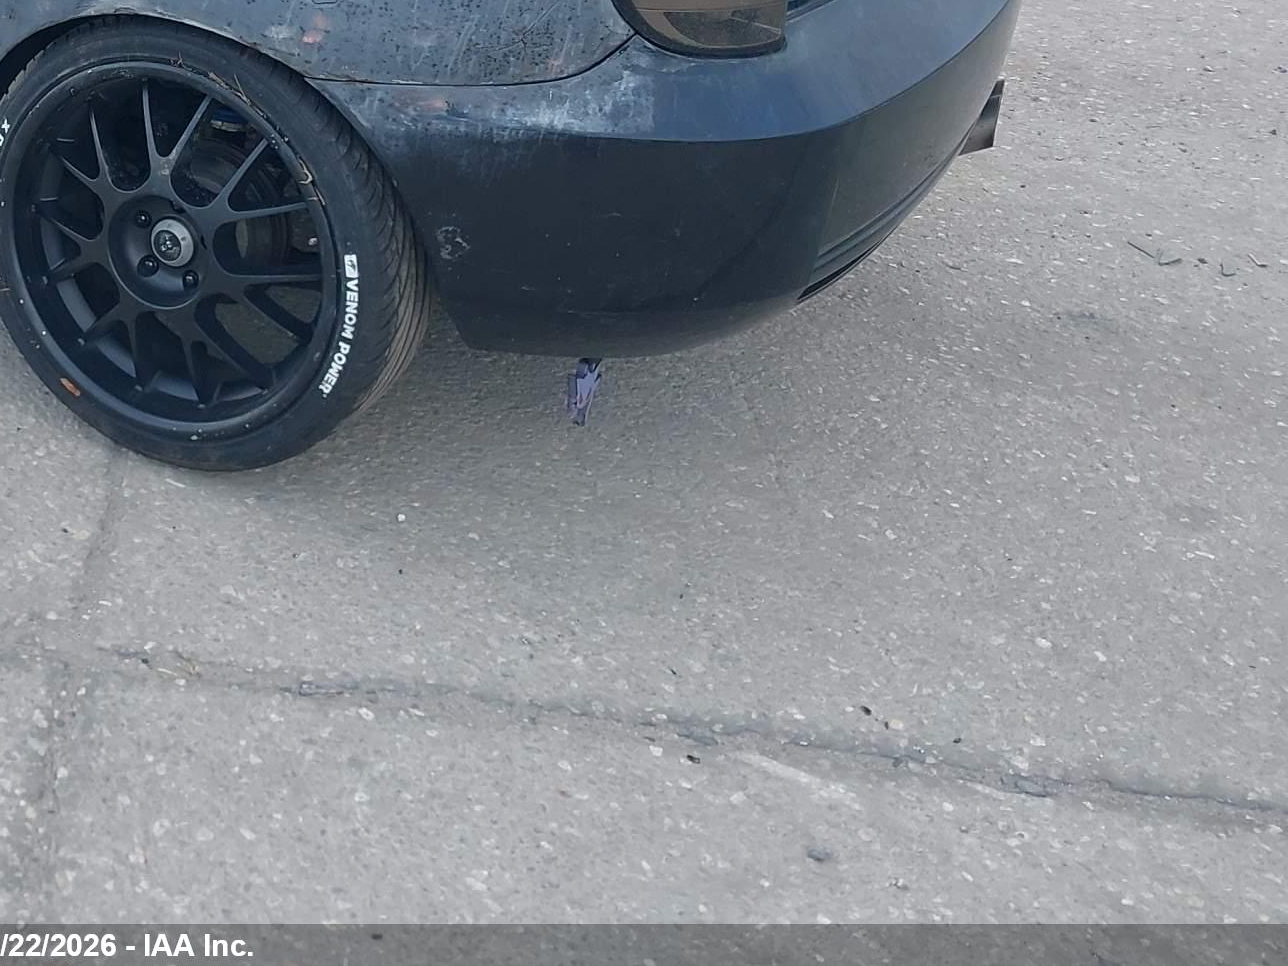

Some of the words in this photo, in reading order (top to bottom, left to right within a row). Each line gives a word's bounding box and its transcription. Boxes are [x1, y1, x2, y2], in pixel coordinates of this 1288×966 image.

[0, 118, 11, 134] X
[341, 278, 359, 340] VENOM
[318, 341, 351, 394] POWER
